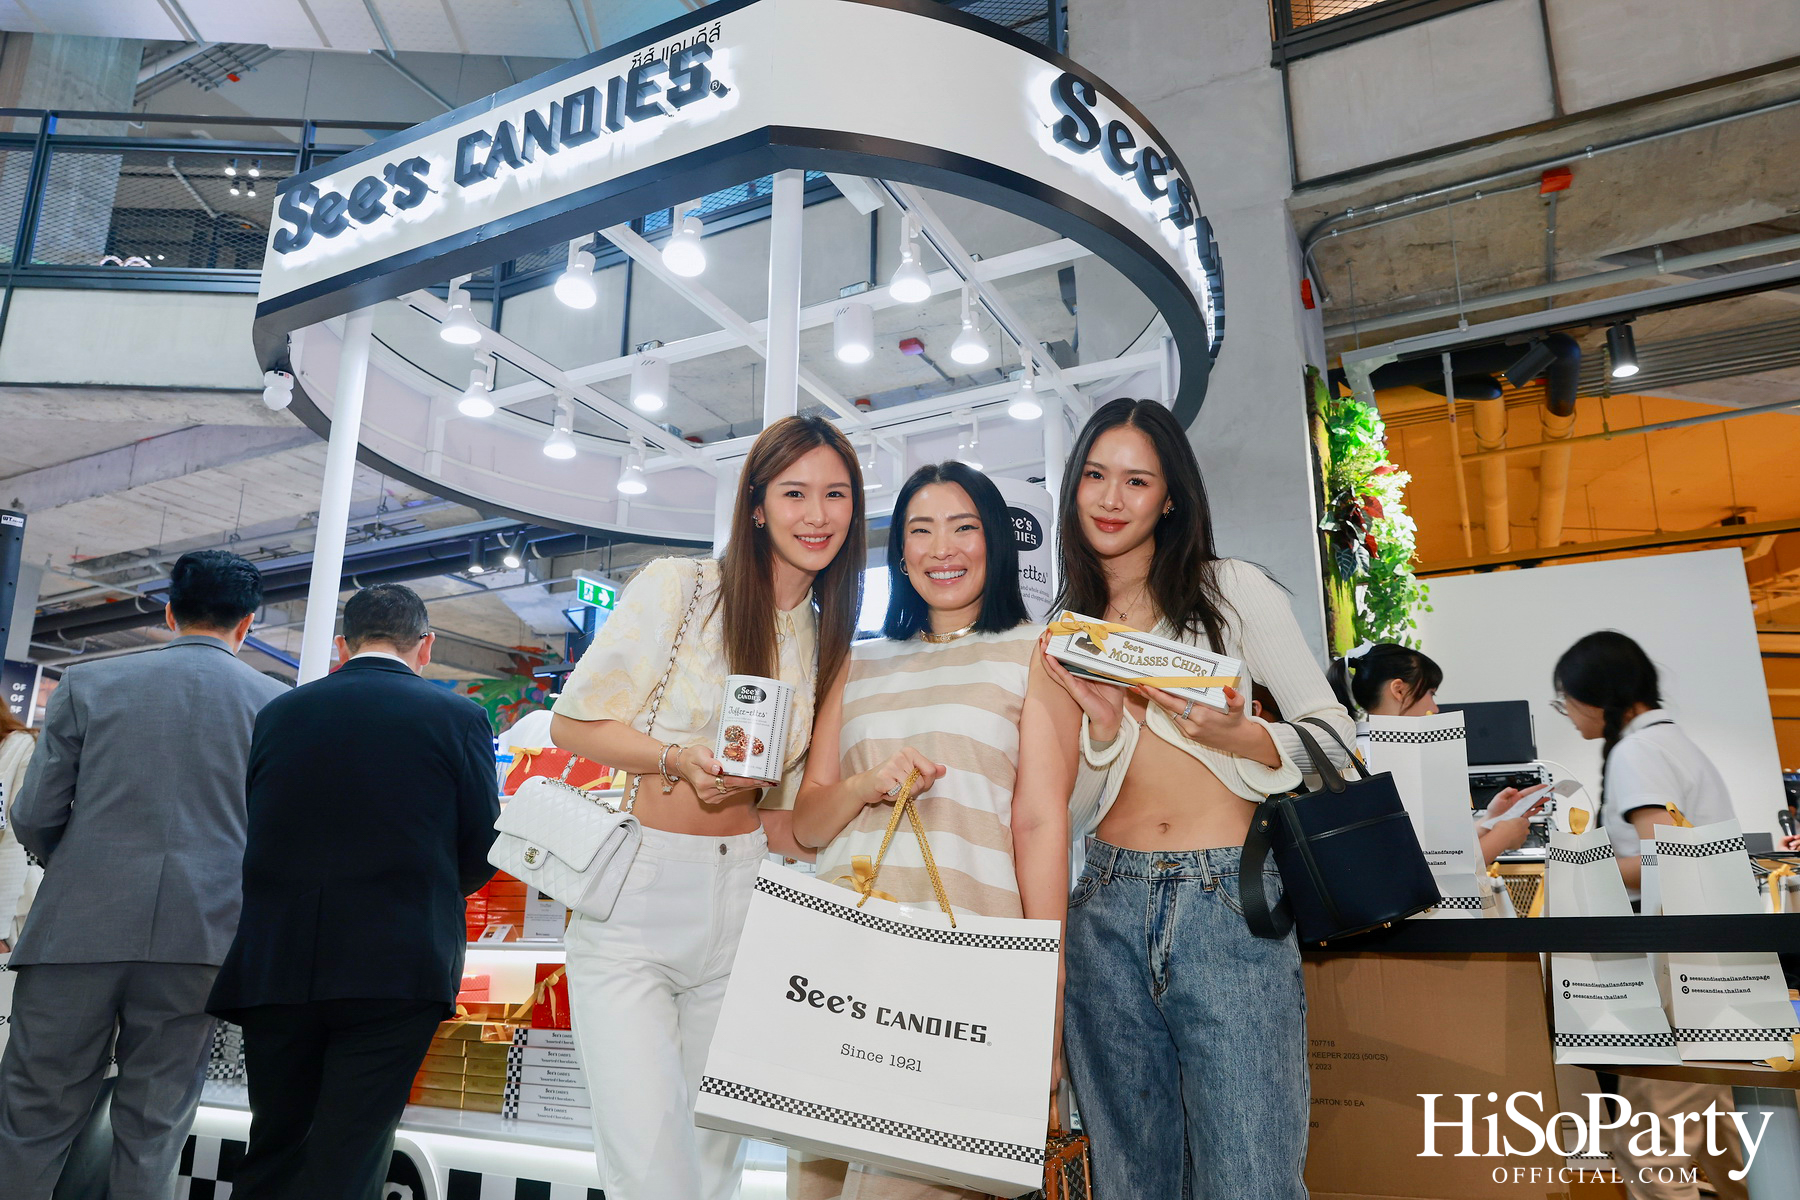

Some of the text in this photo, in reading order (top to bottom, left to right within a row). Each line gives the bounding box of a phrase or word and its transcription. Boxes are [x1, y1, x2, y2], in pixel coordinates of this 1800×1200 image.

[272, 41, 713, 255] See's CANDIES
[1050, 72, 1195, 230] See's
[1011, 516, 1033, 532] e's
[1015, 530, 1037, 545] DIES
[1122, 640, 1145, 653] See's
[1107, 647, 1169, 668] MOLASSES
[785, 974, 988, 1044] See's CANDIES
[840, 1043, 922, 1073] Since 1921
[1361, 1053, 1389, 1061] (50/CS)
